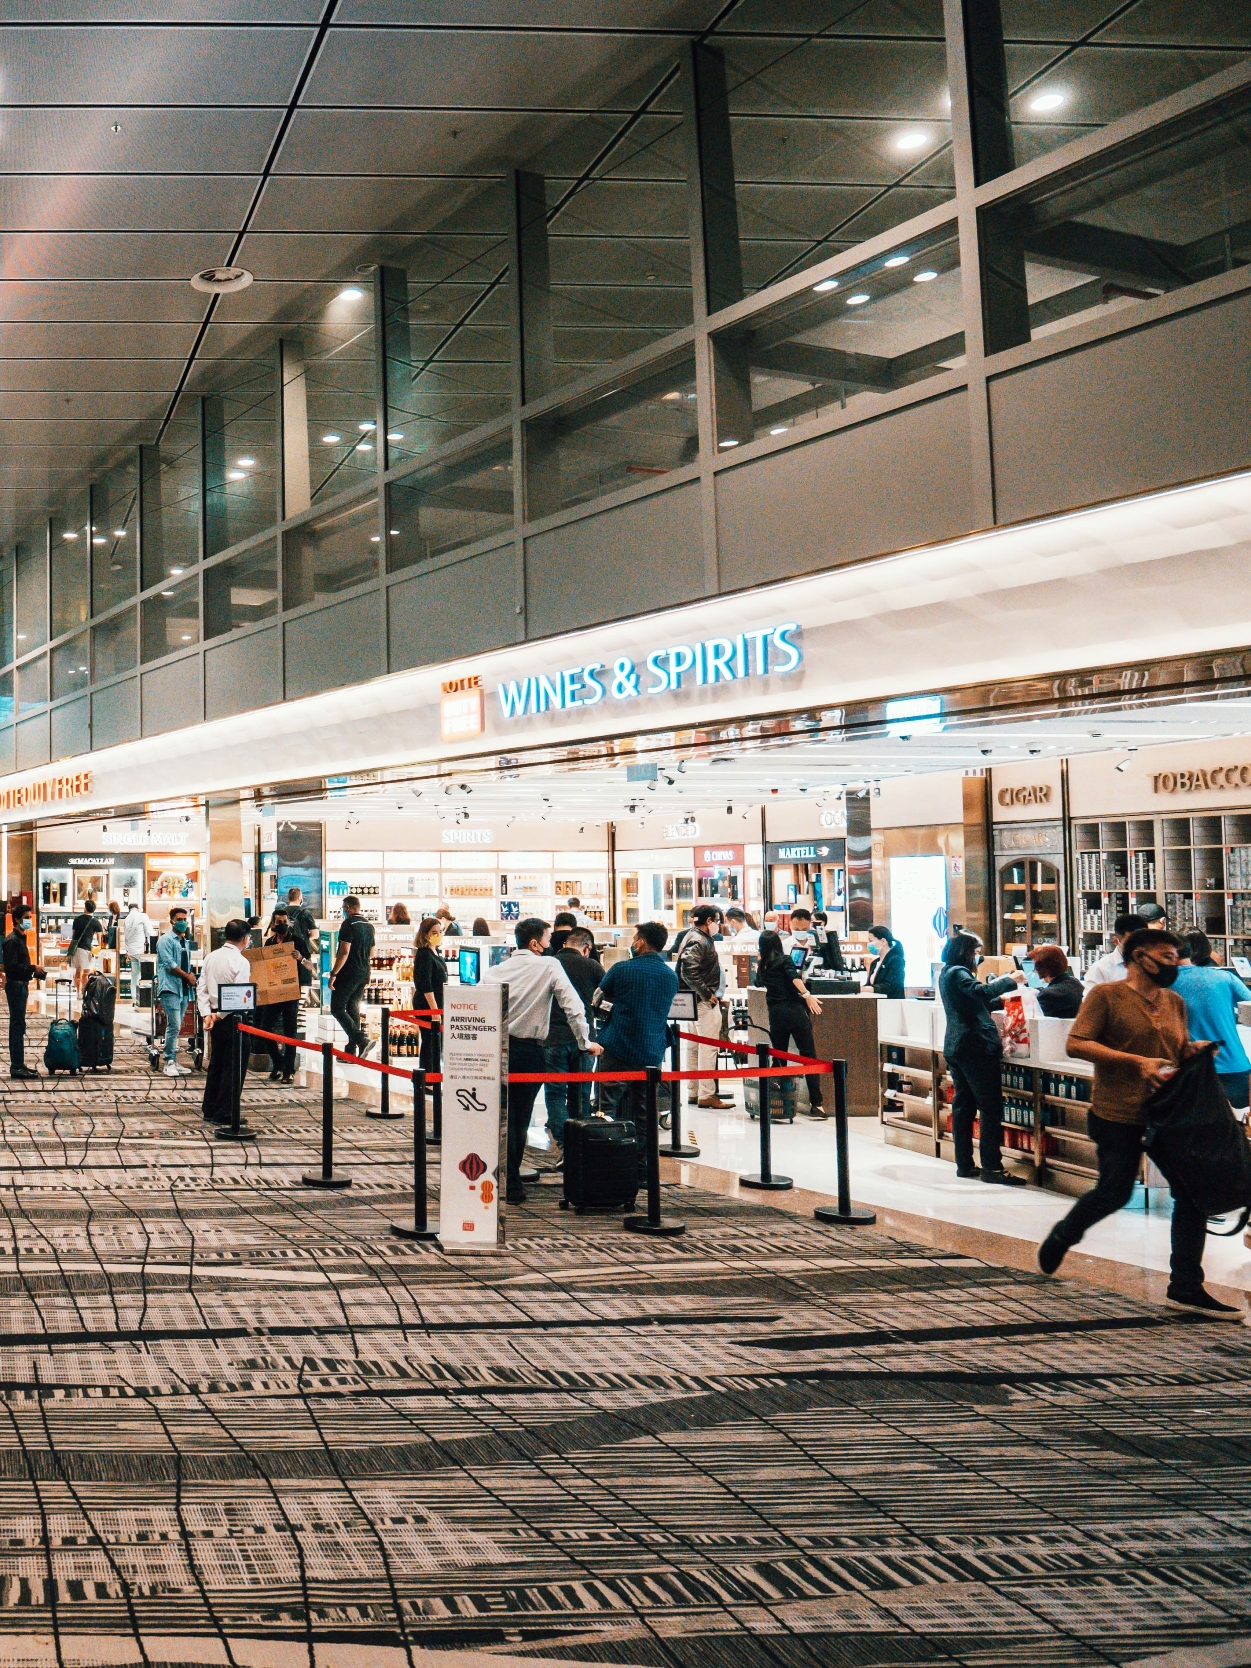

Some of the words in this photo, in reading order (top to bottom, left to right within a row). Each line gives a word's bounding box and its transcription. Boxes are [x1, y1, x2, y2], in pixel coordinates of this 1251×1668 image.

[497, 662, 605, 718] WINES
[612, 656, 640, 700] &
[647, 622, 802, 694] SPIRITS
[440, 674, 483, 694] LOTTE
[1147, 763, 1251, 794] TOBACCO
[23, 778, 56, 806] DUTY
[56, 770, 93, 800] FREE
[998, 784, 1052, 807] CIGAR
[102, 832, 148, 846] SINGLE
[151, 832, 188, 846] MALT
[442, 830, 493, 844] SPIRITS
[711, 850, 734, 861] CHIVAS
[778, 847, 816, 859] MARTELL
[389, 933, 414, 941] SPIRITS
[733, 944, 759, 952] WORL
[840, 944, 863, 952] ORLD
